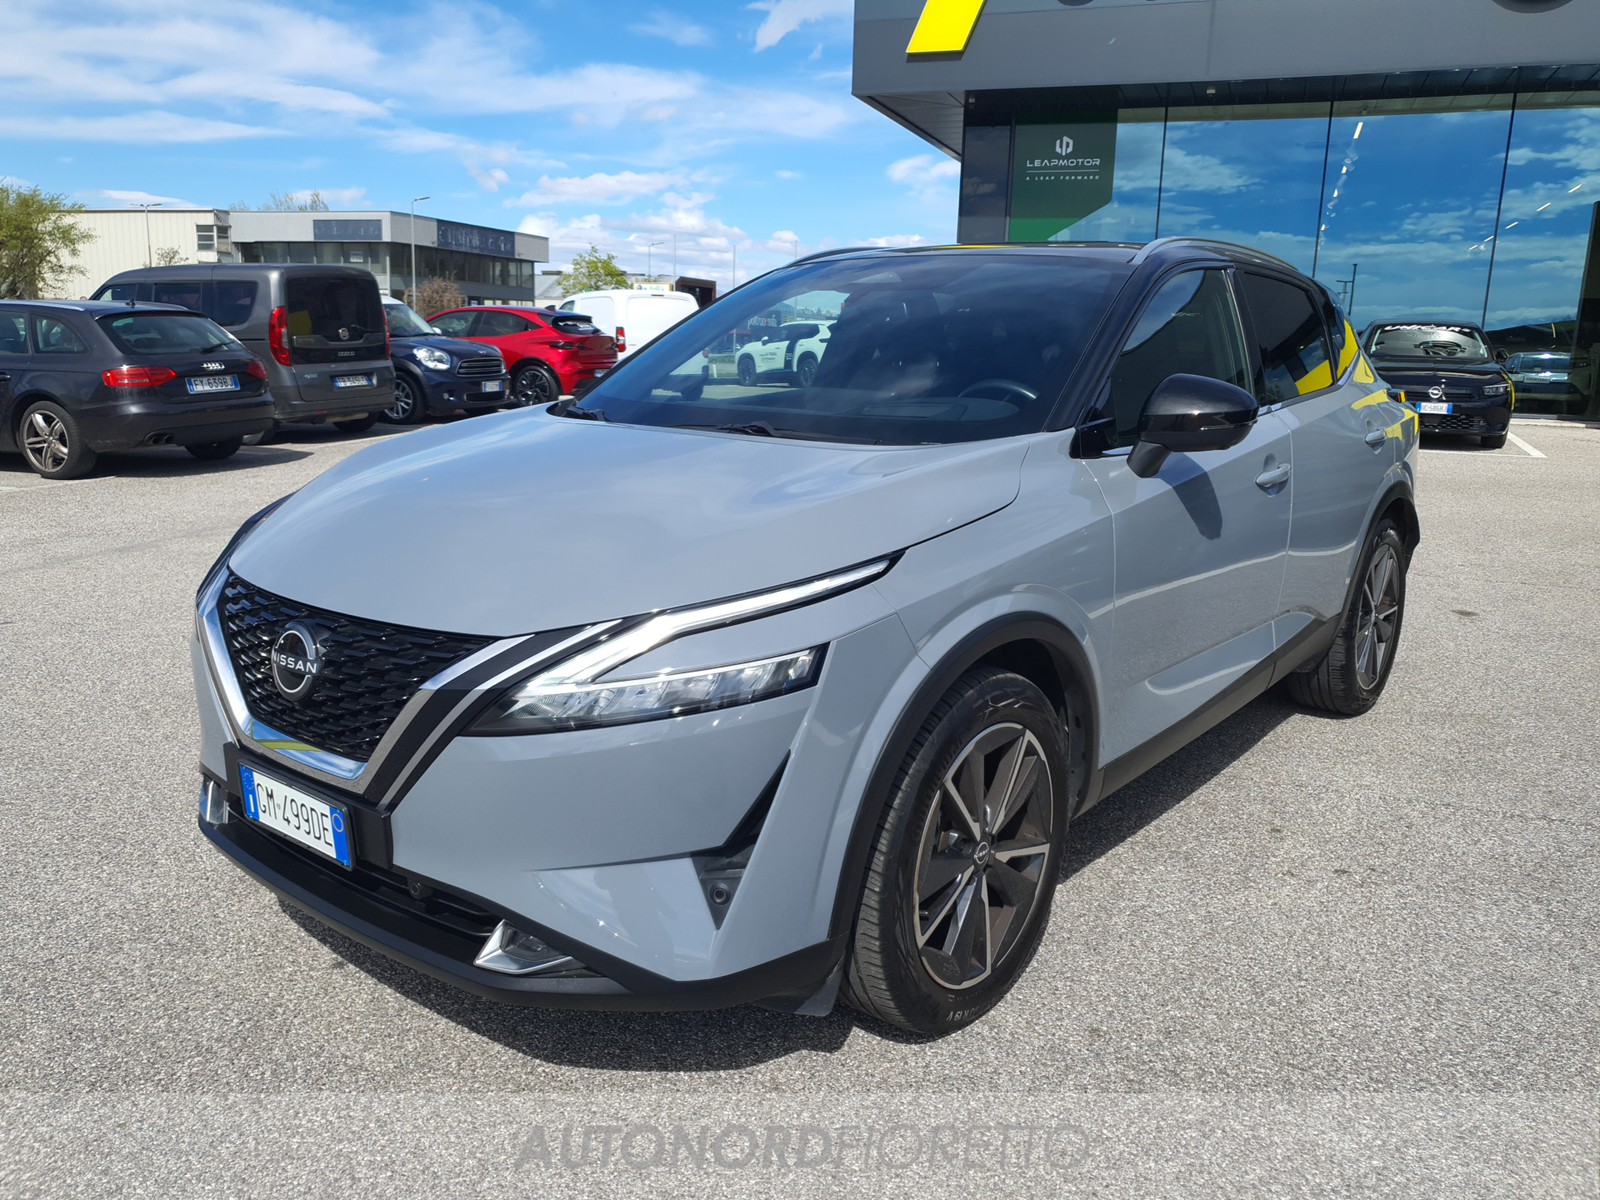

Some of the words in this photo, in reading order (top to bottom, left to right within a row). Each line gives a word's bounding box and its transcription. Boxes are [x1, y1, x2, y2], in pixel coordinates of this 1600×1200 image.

[1026, 159, 1101, 167] LEAPMOTOR
[193, 379, 205, 390] FY
[273, 651, 317, 674] NISSAN
[256, 783, 277, 820] GM
[283, 795, 334, 848] 499DE
